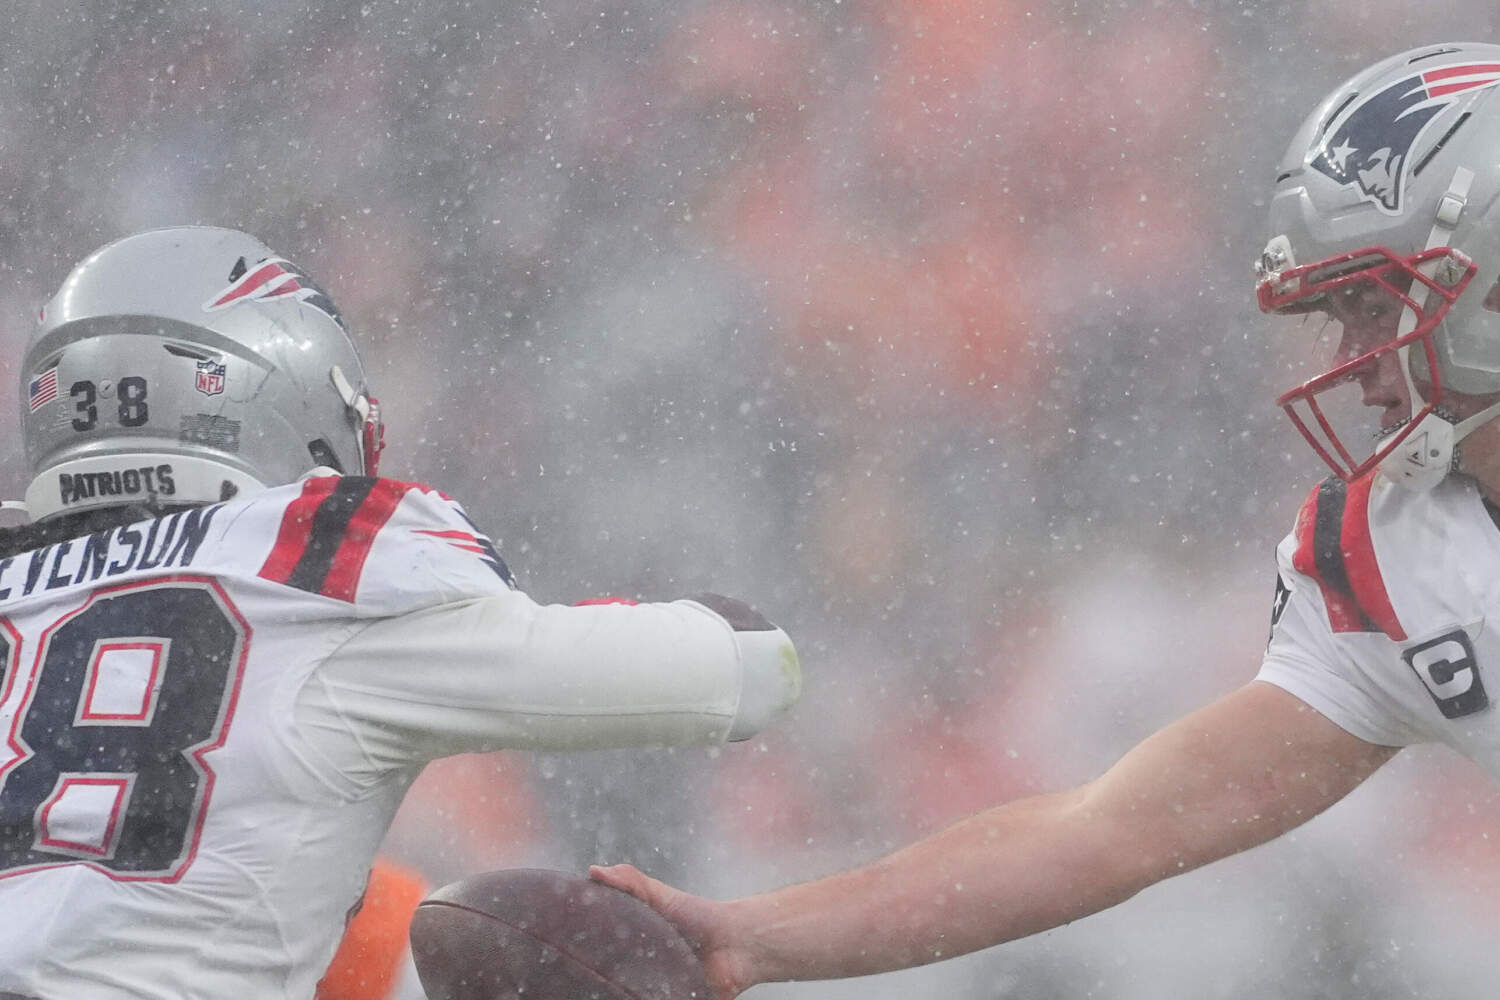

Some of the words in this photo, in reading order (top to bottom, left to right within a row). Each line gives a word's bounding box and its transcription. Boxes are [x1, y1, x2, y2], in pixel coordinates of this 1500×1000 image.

[198, 374, 222, 393] NFL
[59, 464, 176, 505] PATRIOTS
[1412, 640, 1474, 701] C
[0, 574, 254, 885] 8
